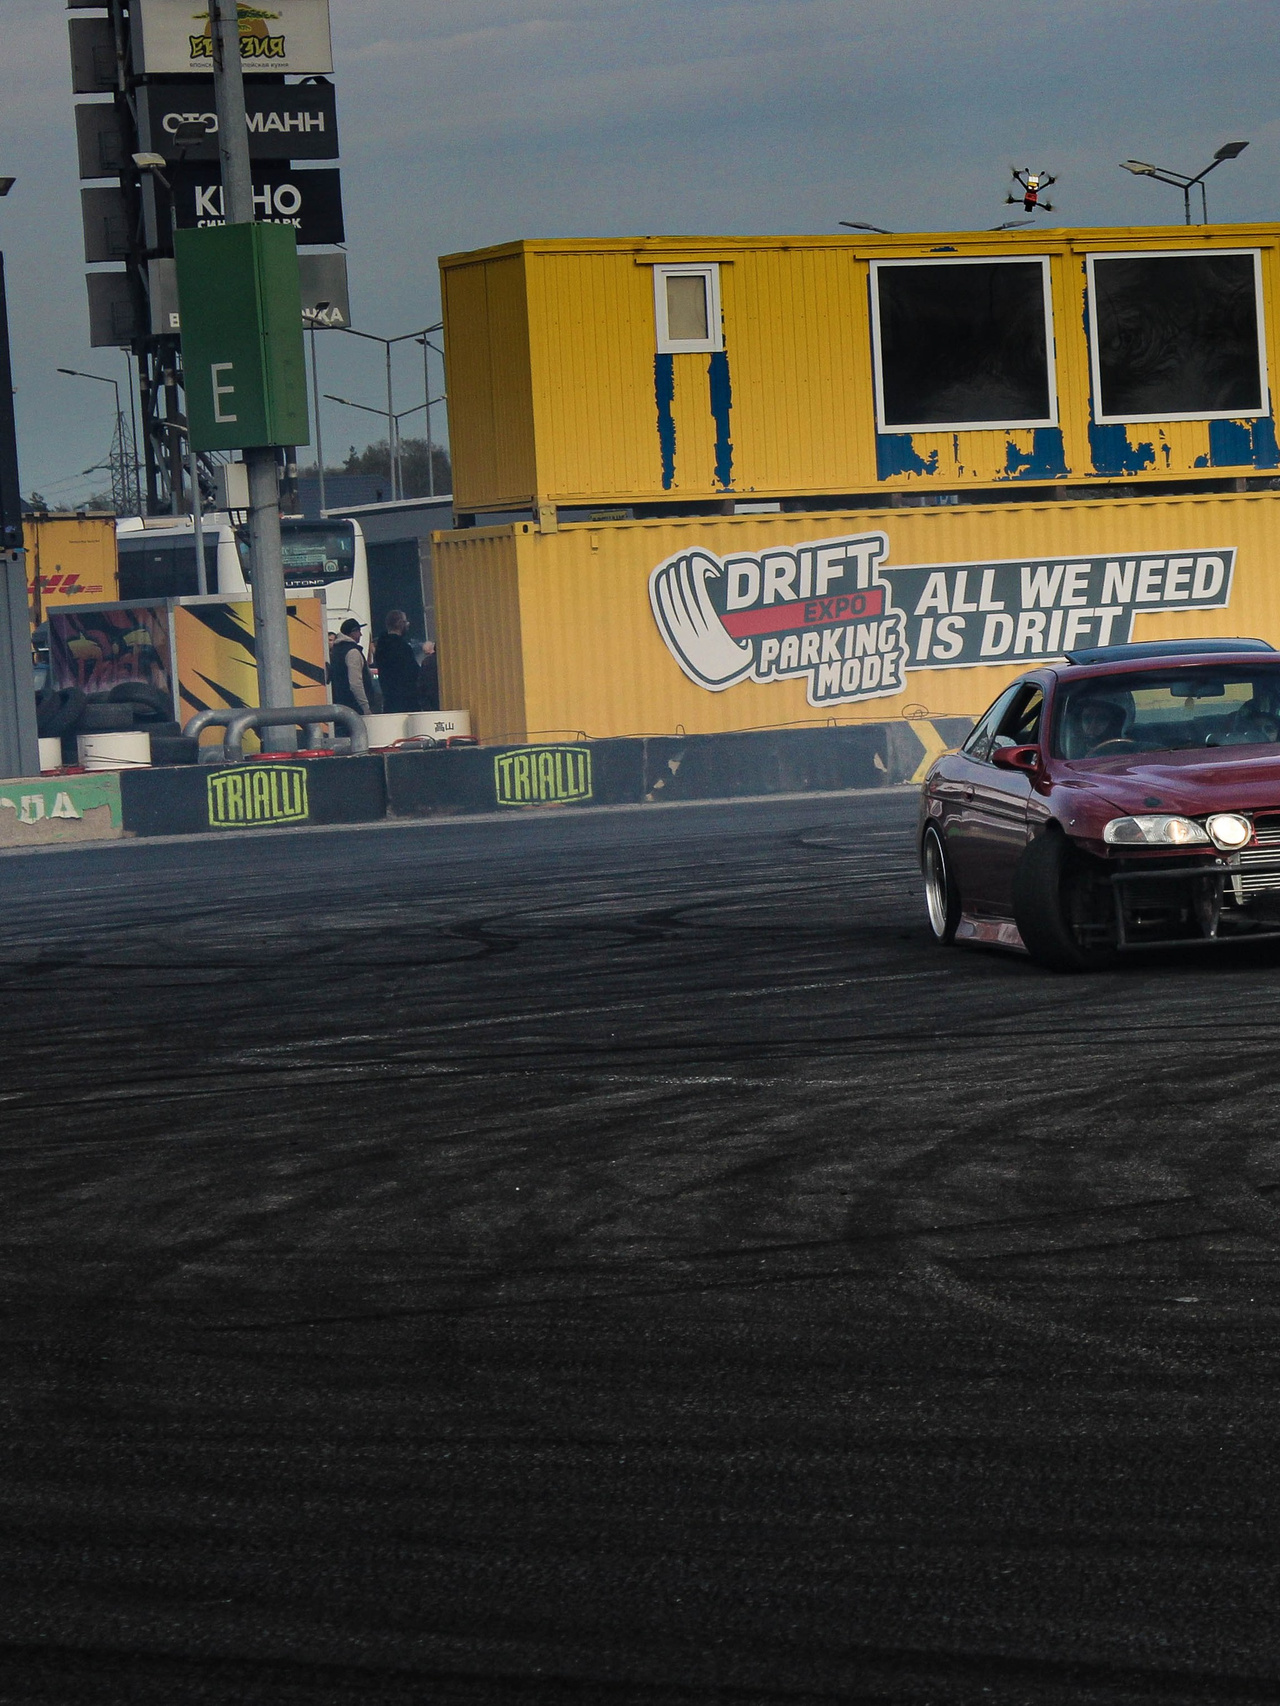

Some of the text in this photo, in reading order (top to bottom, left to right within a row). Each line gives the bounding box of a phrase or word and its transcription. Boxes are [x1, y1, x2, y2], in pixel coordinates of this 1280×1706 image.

[727, 541, 880, 610] DRIFT
[914, 556, 1225, 615] ALL WE NEED
[803, 593, 867, 623] EXPO
[915, 607, 1123, 660] IS DRIFT
[760, 618, 898, 673] PARKING
[817, 651, 900, 697] MODE
[211, 771, 303, 821] TRIALLI
[499, 751, 585, 800] TRIALLI
